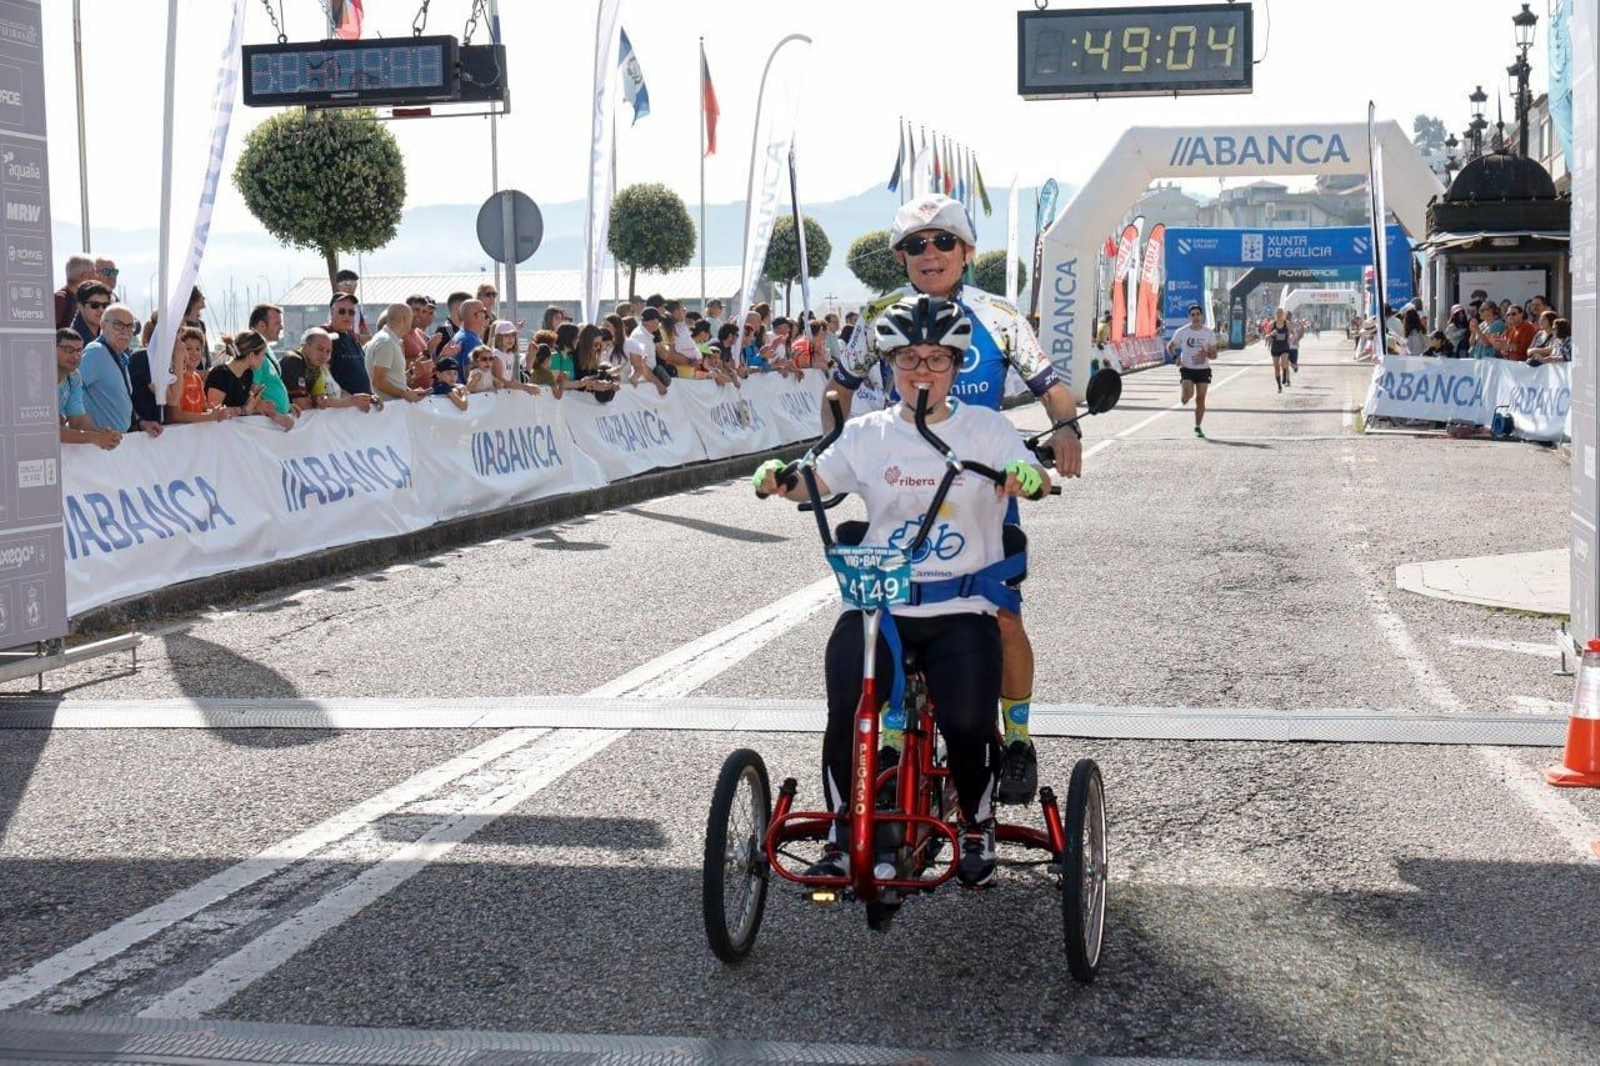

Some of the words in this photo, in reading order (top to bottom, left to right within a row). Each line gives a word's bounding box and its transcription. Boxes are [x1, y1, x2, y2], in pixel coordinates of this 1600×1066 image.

[6, 201, 41, 222] MRW
[1267, 235, 1308, 246] XUNTA
[1267, 247, 1282, 258] DE
[1284, 246, 1332, 258] GALICIA
[900, 476, 935, 486] ribera
[849, 577, 899, 604] 4149
[855, 743, 868, 815] PEGASO
